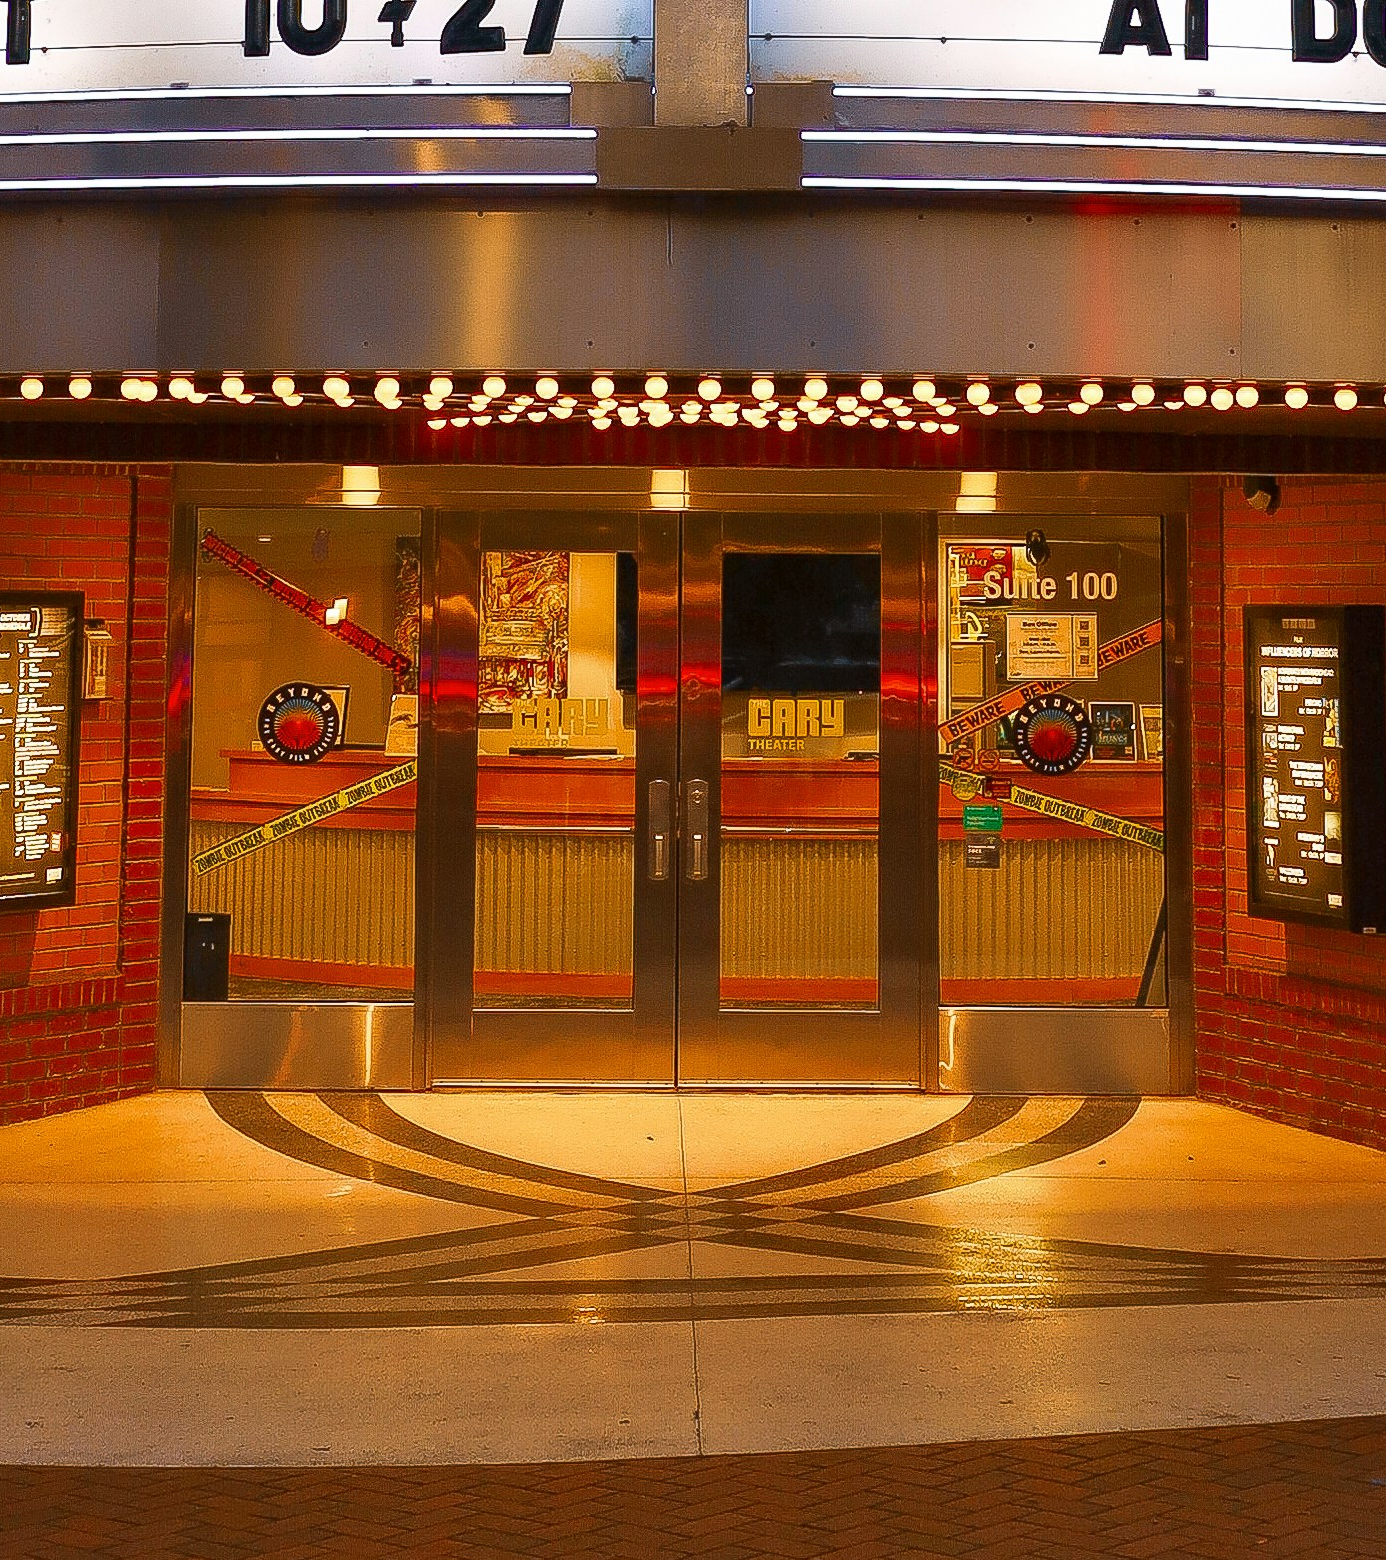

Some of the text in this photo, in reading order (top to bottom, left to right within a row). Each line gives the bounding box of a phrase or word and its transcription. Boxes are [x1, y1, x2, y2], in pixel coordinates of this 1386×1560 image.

[983, 570, 1118, 600] Suite 100
[266, 687, 331, 712] BEYOND
[1019, 698, 1084, 724] BEYOND
[513, 699, 609, 736] CARY
[748, 699, 844, 737] CARY
[947, 701, 1006, 738] BEWARE
[748, 738, 805, 750] THEATER
